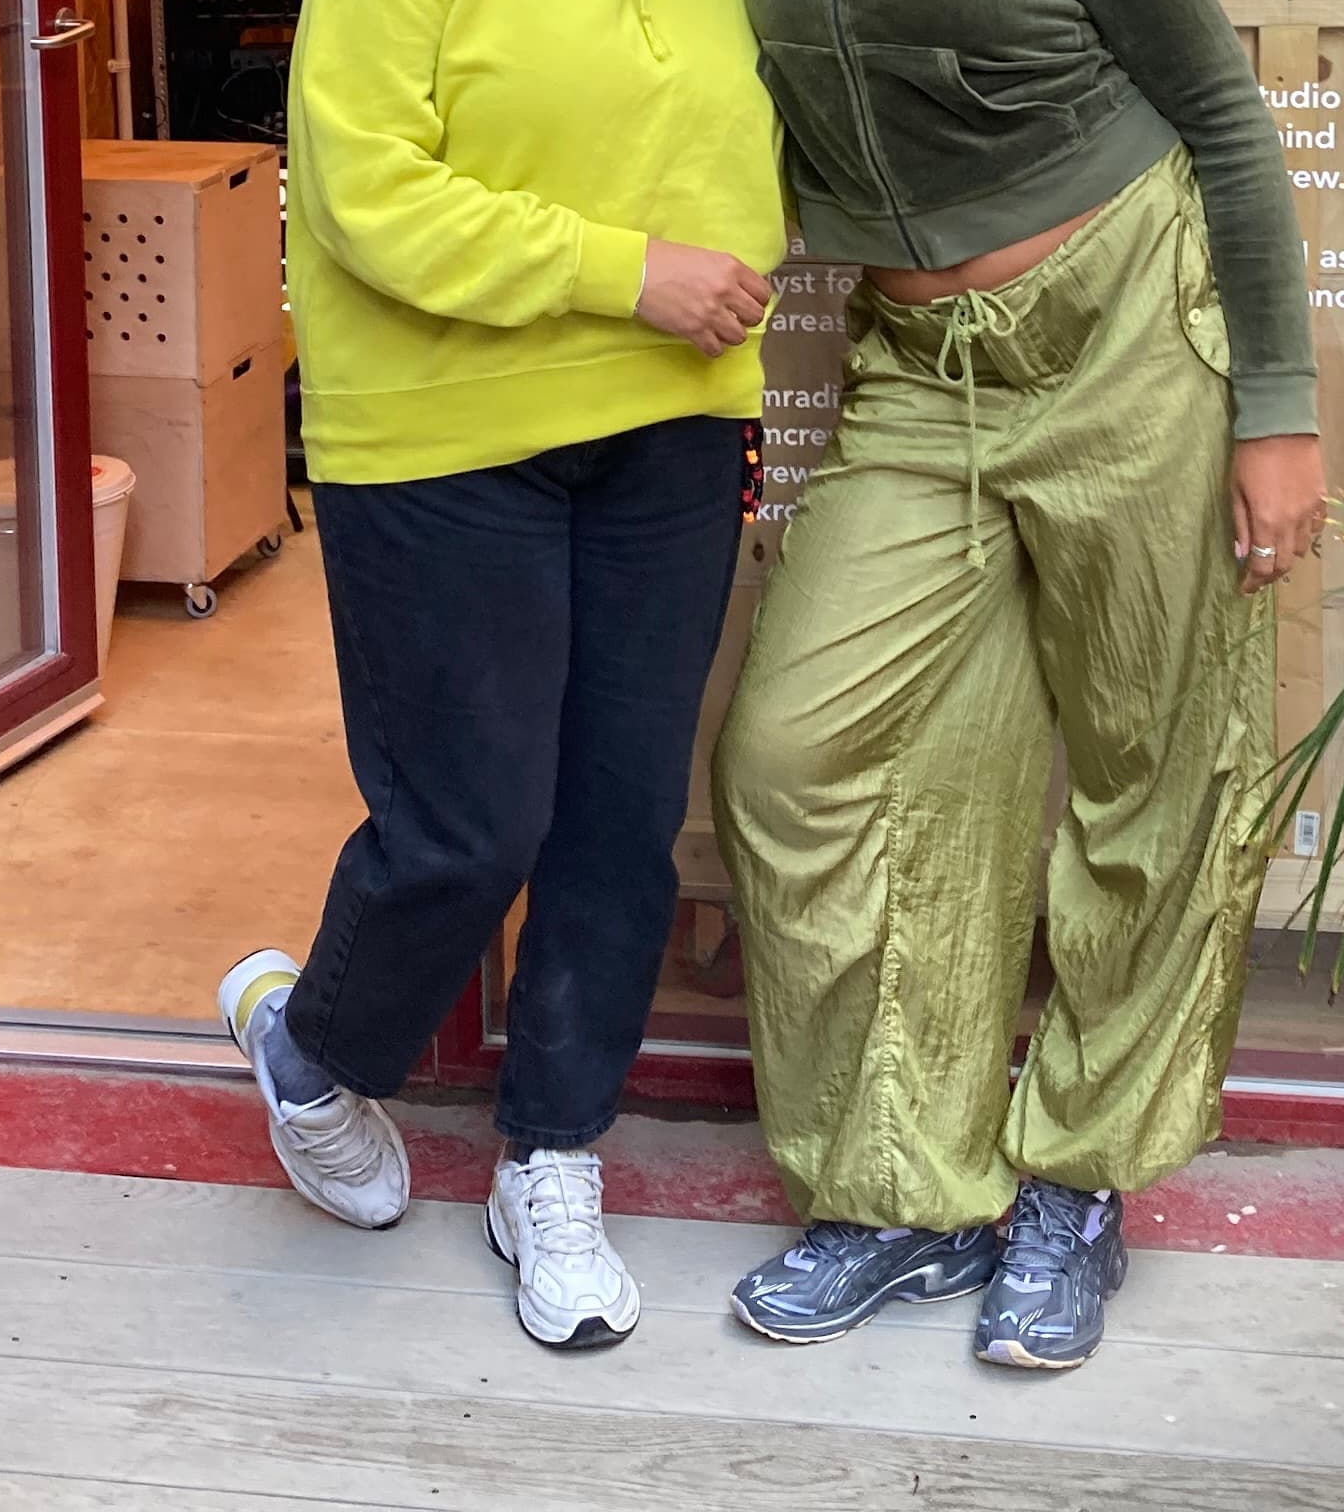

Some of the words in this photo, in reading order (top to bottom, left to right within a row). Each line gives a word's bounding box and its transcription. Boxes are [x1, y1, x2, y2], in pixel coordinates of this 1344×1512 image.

[1259, 81, 1341, 110] tudio
[762, 382, 839, 409] mradi
[763, 426, 833, 447] mcre
[763, 465, 817, 484] rew
